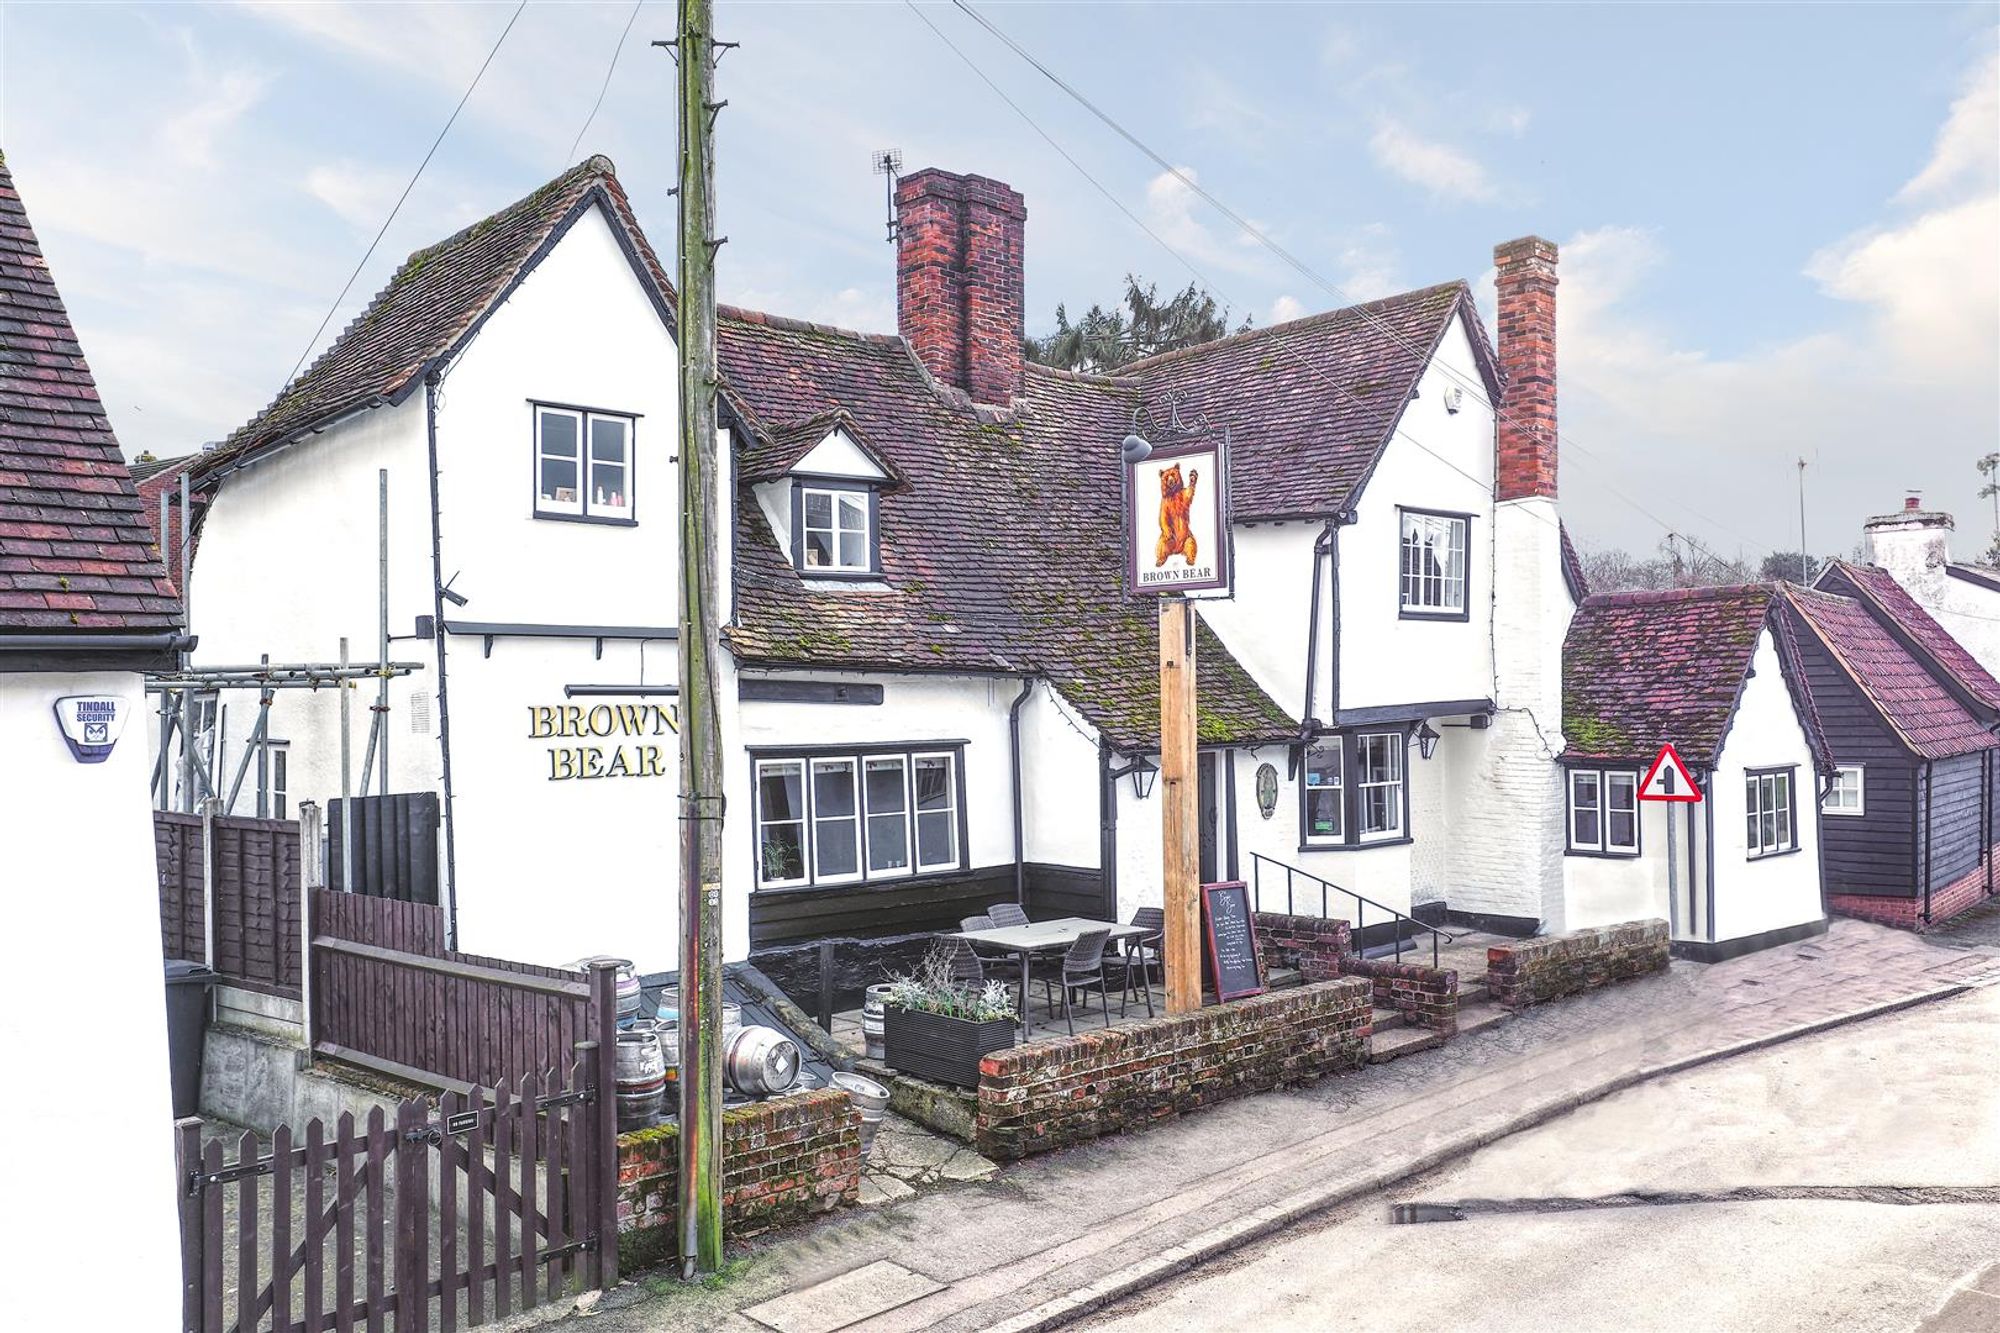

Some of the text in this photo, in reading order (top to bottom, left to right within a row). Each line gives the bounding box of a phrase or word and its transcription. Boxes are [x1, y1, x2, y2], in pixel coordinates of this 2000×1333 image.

[1143, 567, 1211, 582] BROWN BEAR
[76, 701, 116, 711] TINDALL
[76, 713, 116, 722] SECURITY
[527, 703, 680, 738] BROWN
[547, 744, 666, 781] BEAR
